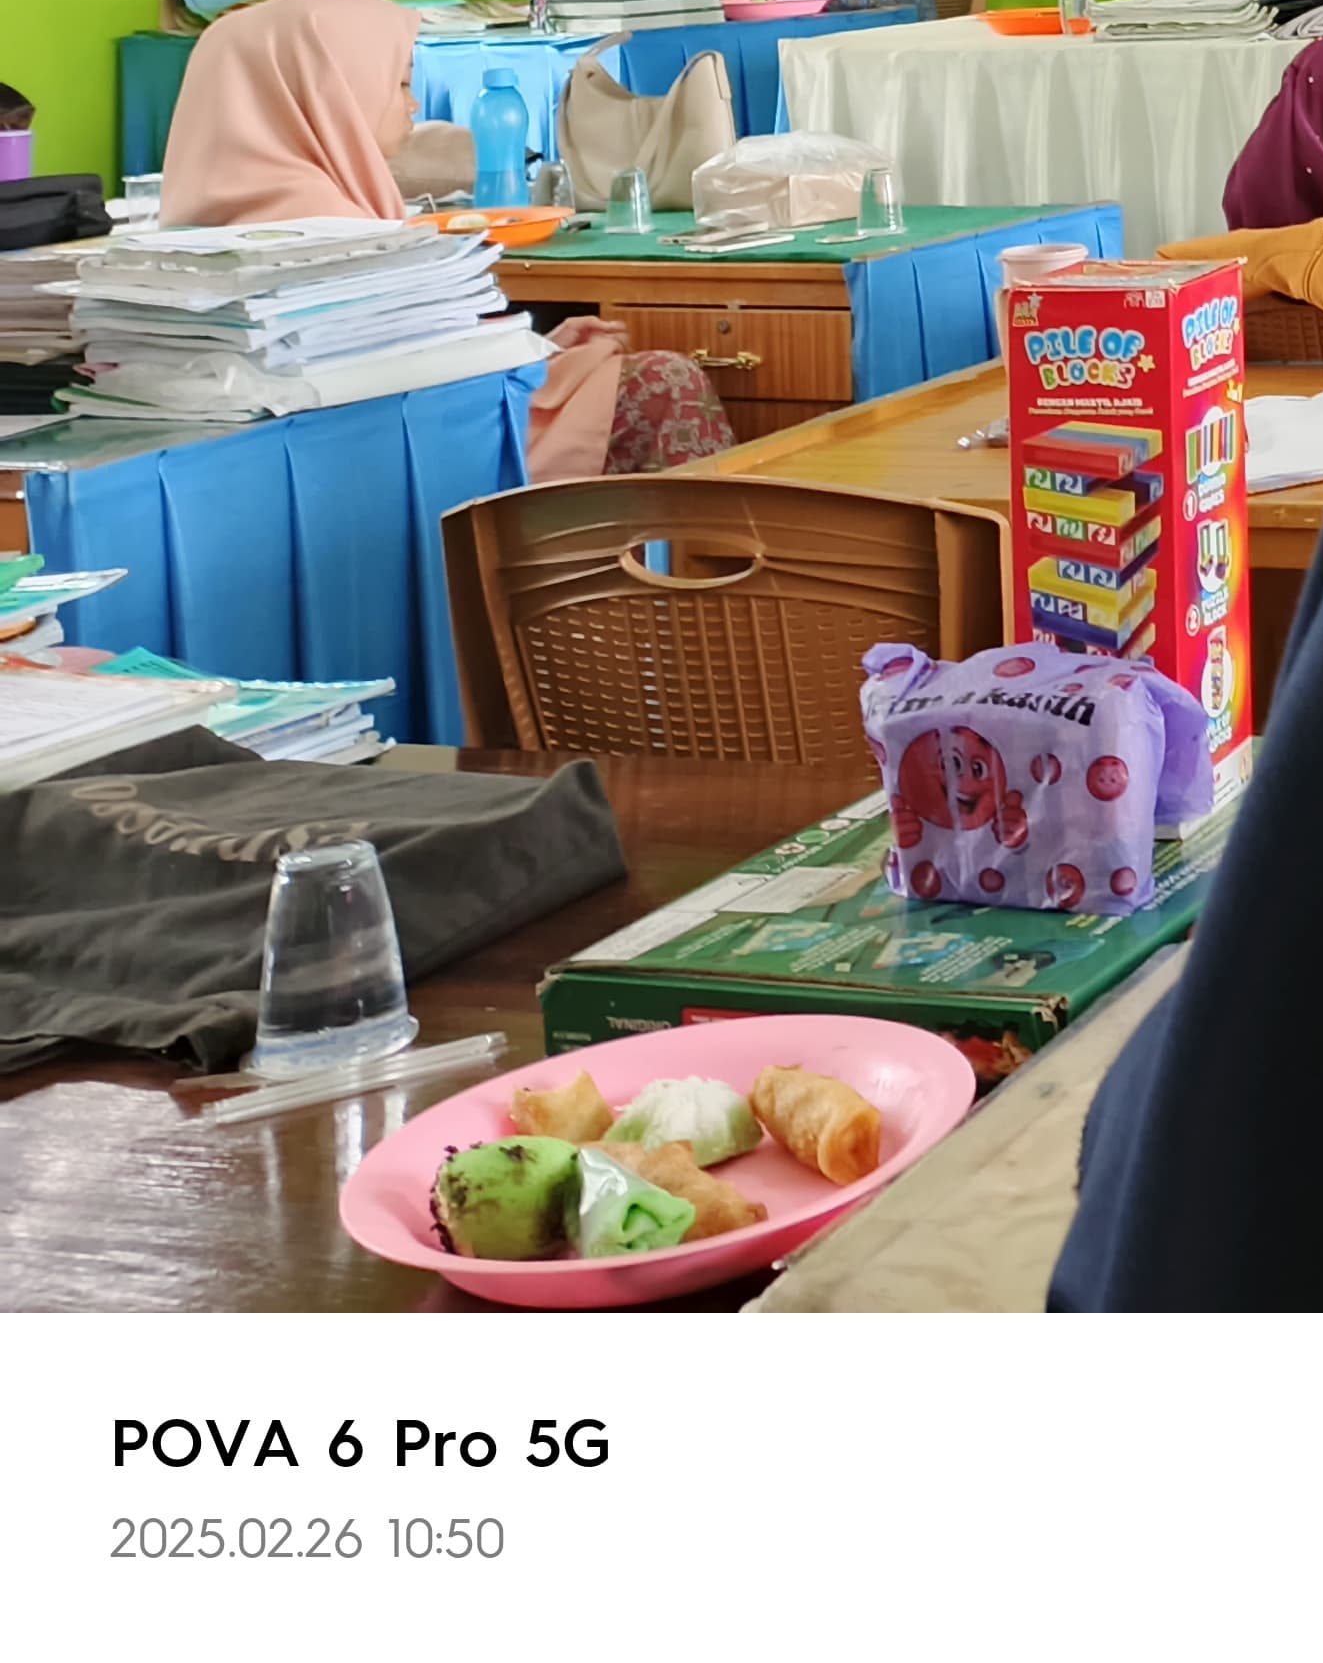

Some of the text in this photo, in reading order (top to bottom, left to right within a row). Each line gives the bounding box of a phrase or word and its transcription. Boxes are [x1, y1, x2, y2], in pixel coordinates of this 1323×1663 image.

[1183, 302, 1219, 348] PILE
[1025, 326, 1144, 364] PILE OF
[1040, 359, 1135, 389] BLOCKS
